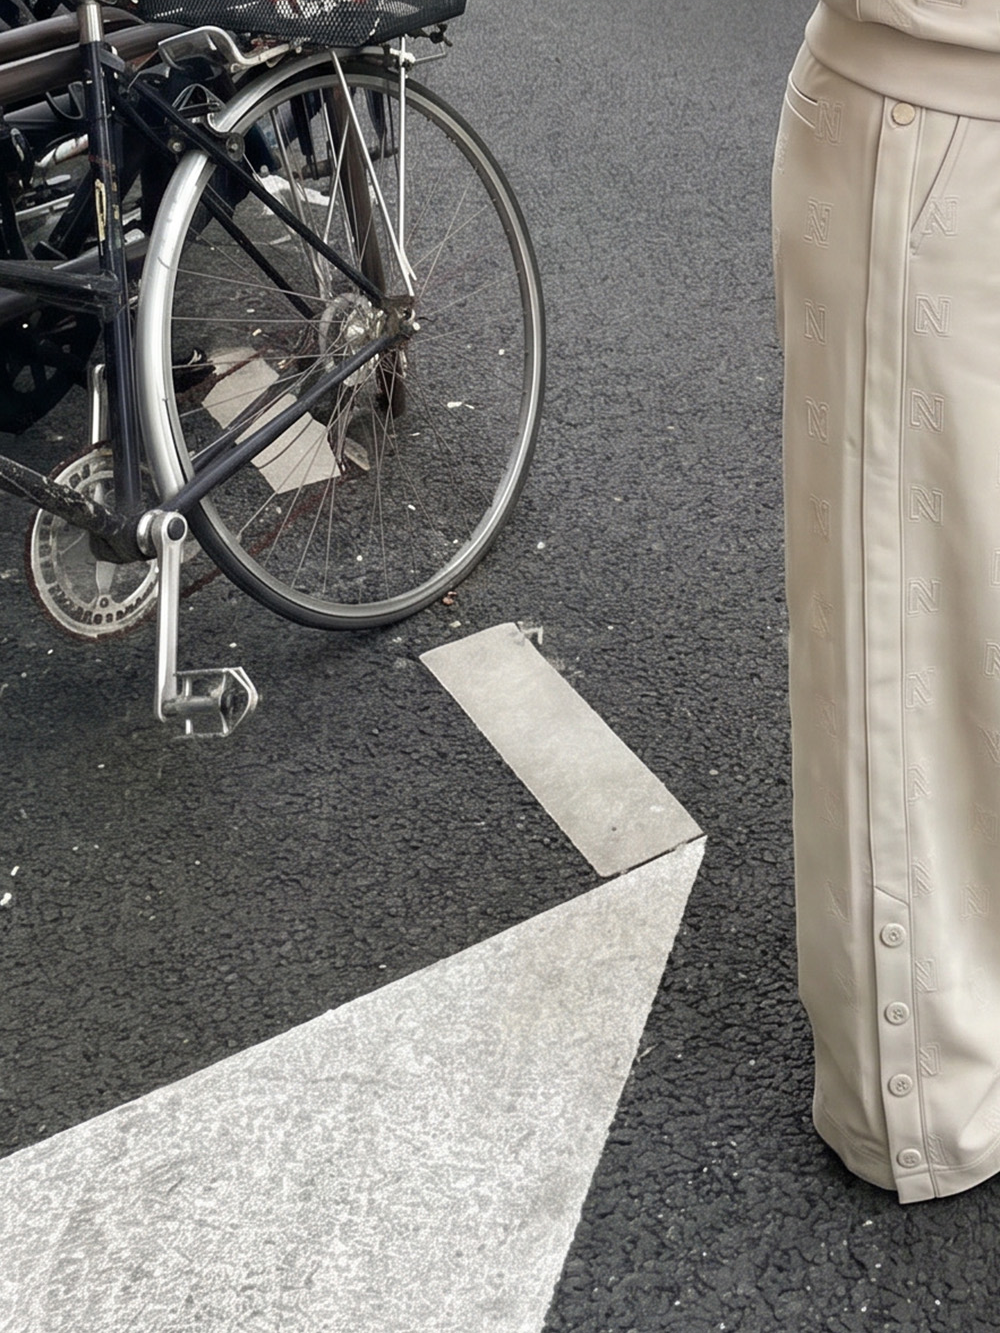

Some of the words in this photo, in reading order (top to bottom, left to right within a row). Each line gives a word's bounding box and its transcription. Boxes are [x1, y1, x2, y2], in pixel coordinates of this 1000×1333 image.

[814, 99, 845, 145] N
[921, 195, 960, 239] N
[913, 291, 952, 338] N
[909, 389, 945, 433] N
[909, 485, 945, 526] N
[906, 577, 942, 615] N
